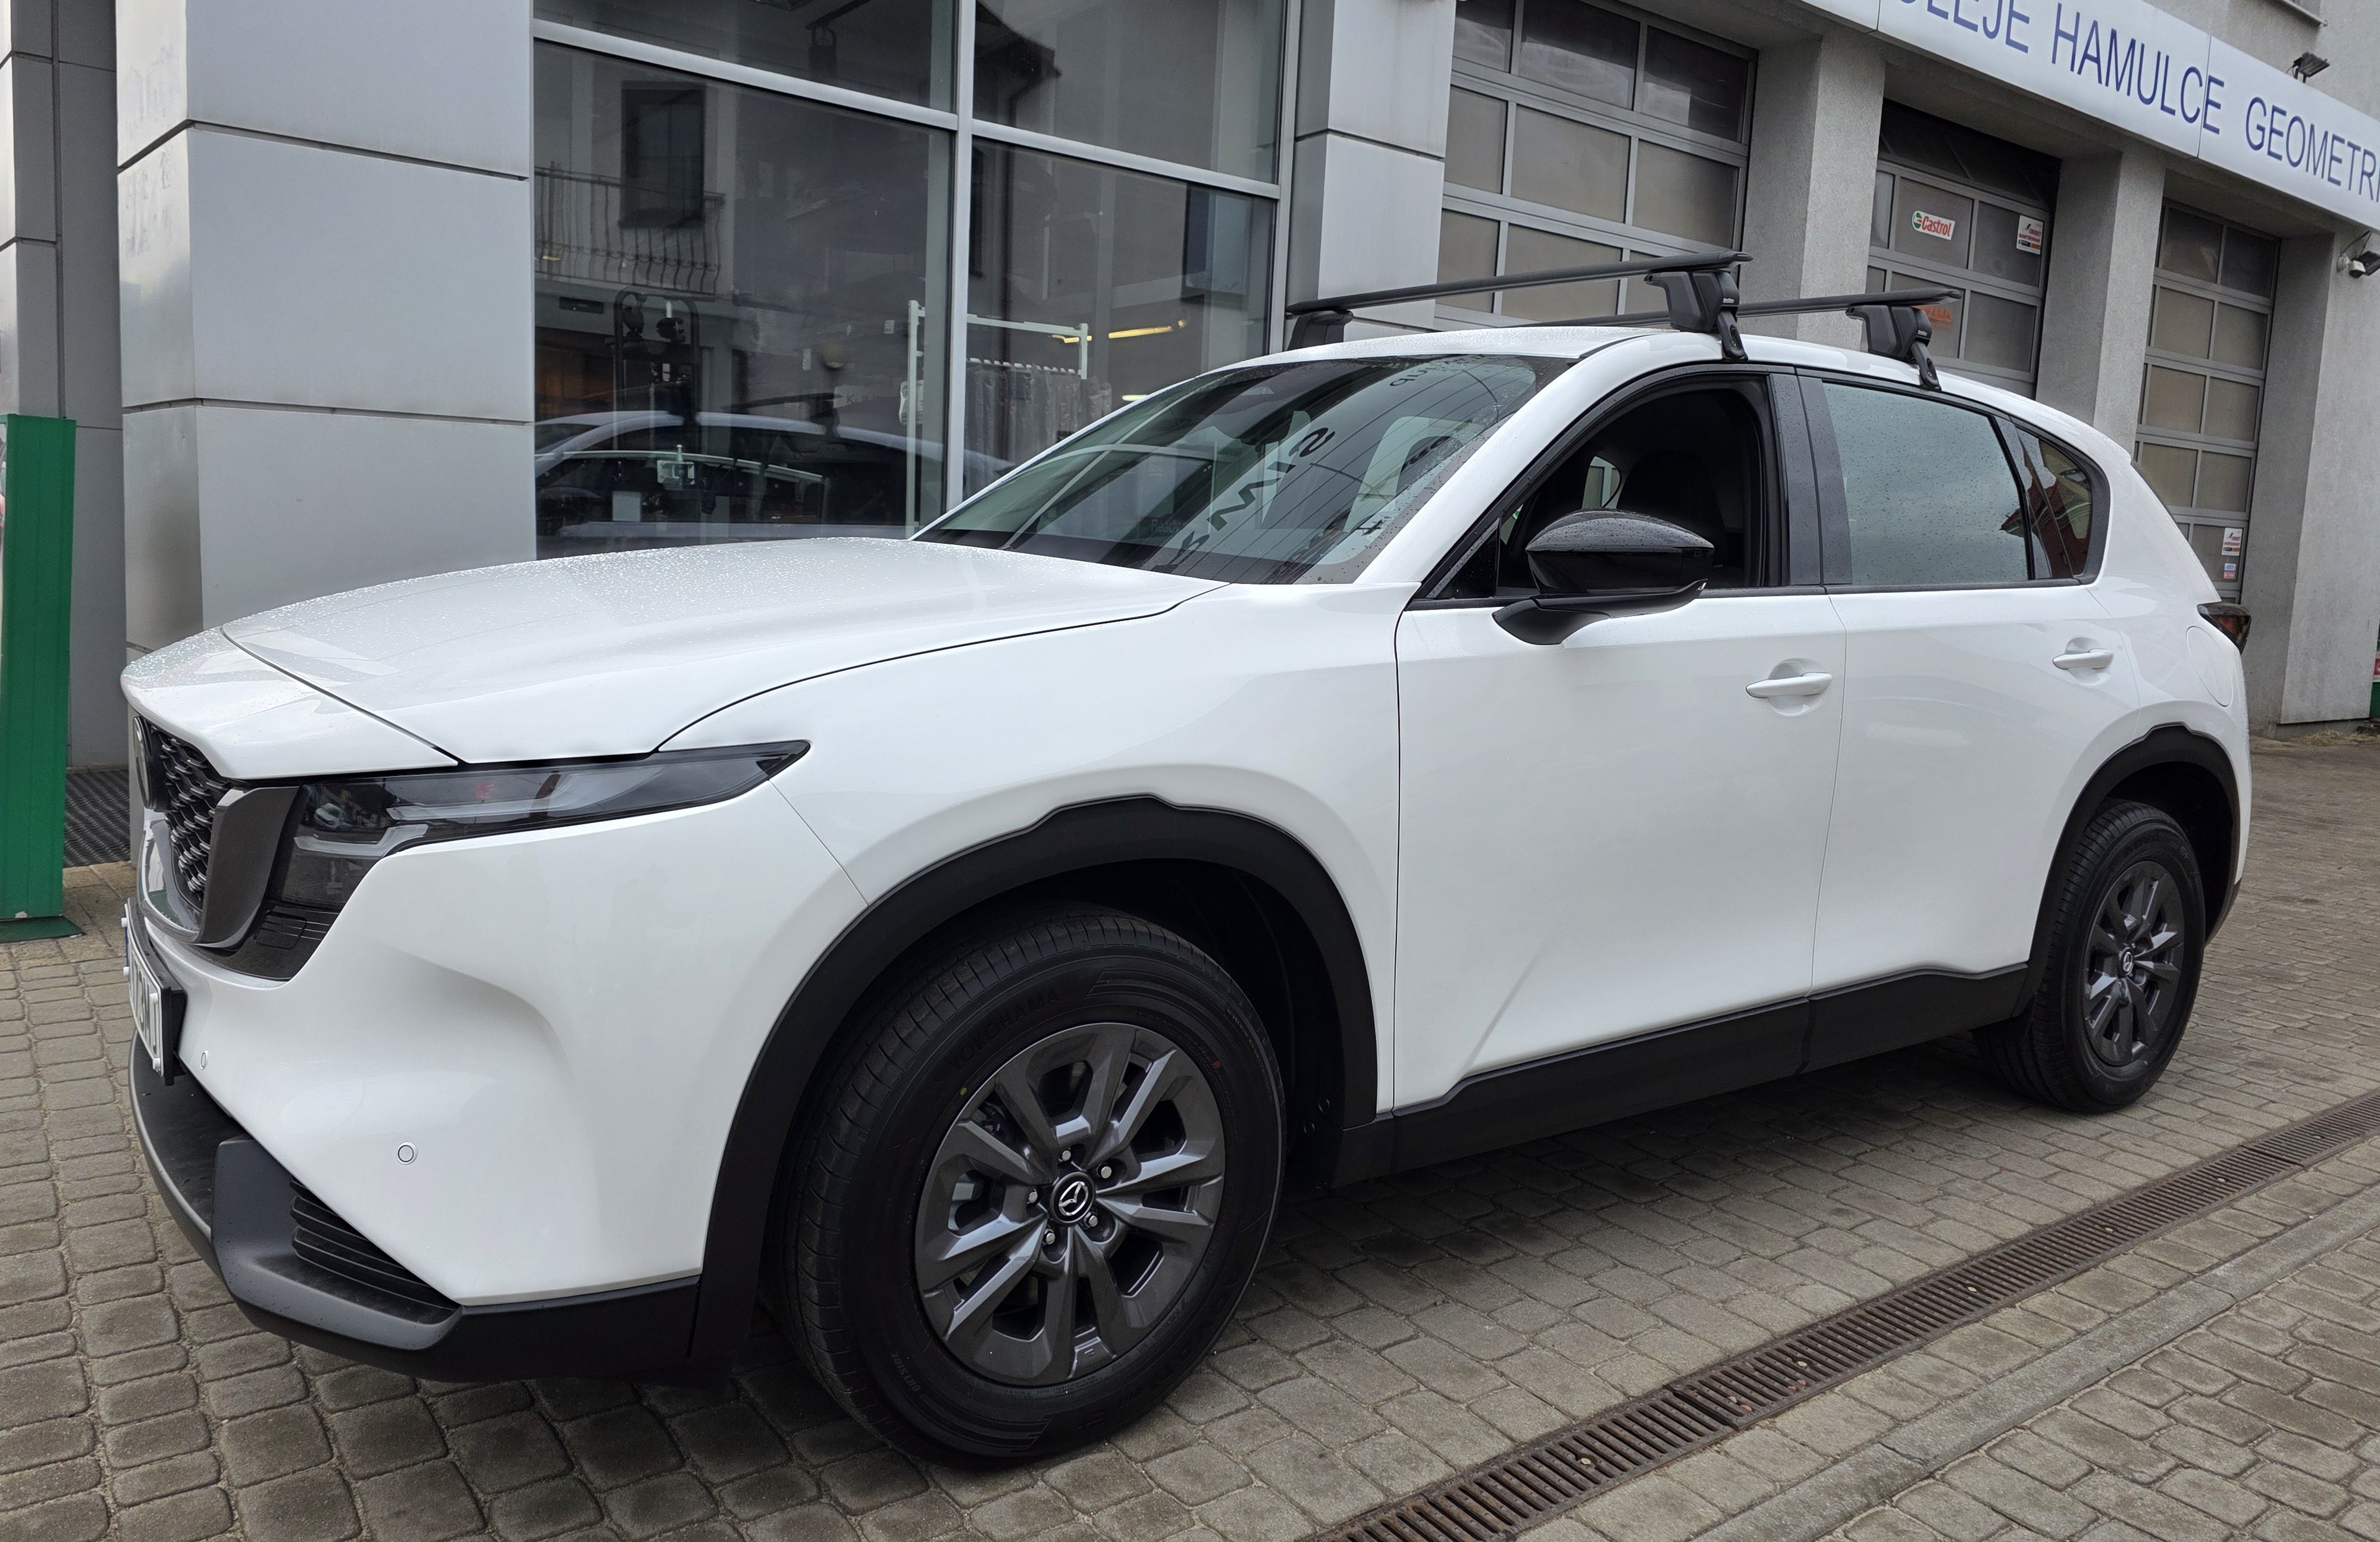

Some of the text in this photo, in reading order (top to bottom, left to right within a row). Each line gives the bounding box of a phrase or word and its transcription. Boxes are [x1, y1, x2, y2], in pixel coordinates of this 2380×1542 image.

[2052, 2, 2224, 135] HAMULCE
[1922, 215, 1952, 237] Castrol
[945, 985, 1060, 1077] YOKOHAMA
[891, 1351, 924, 1395] OUTSIDE
